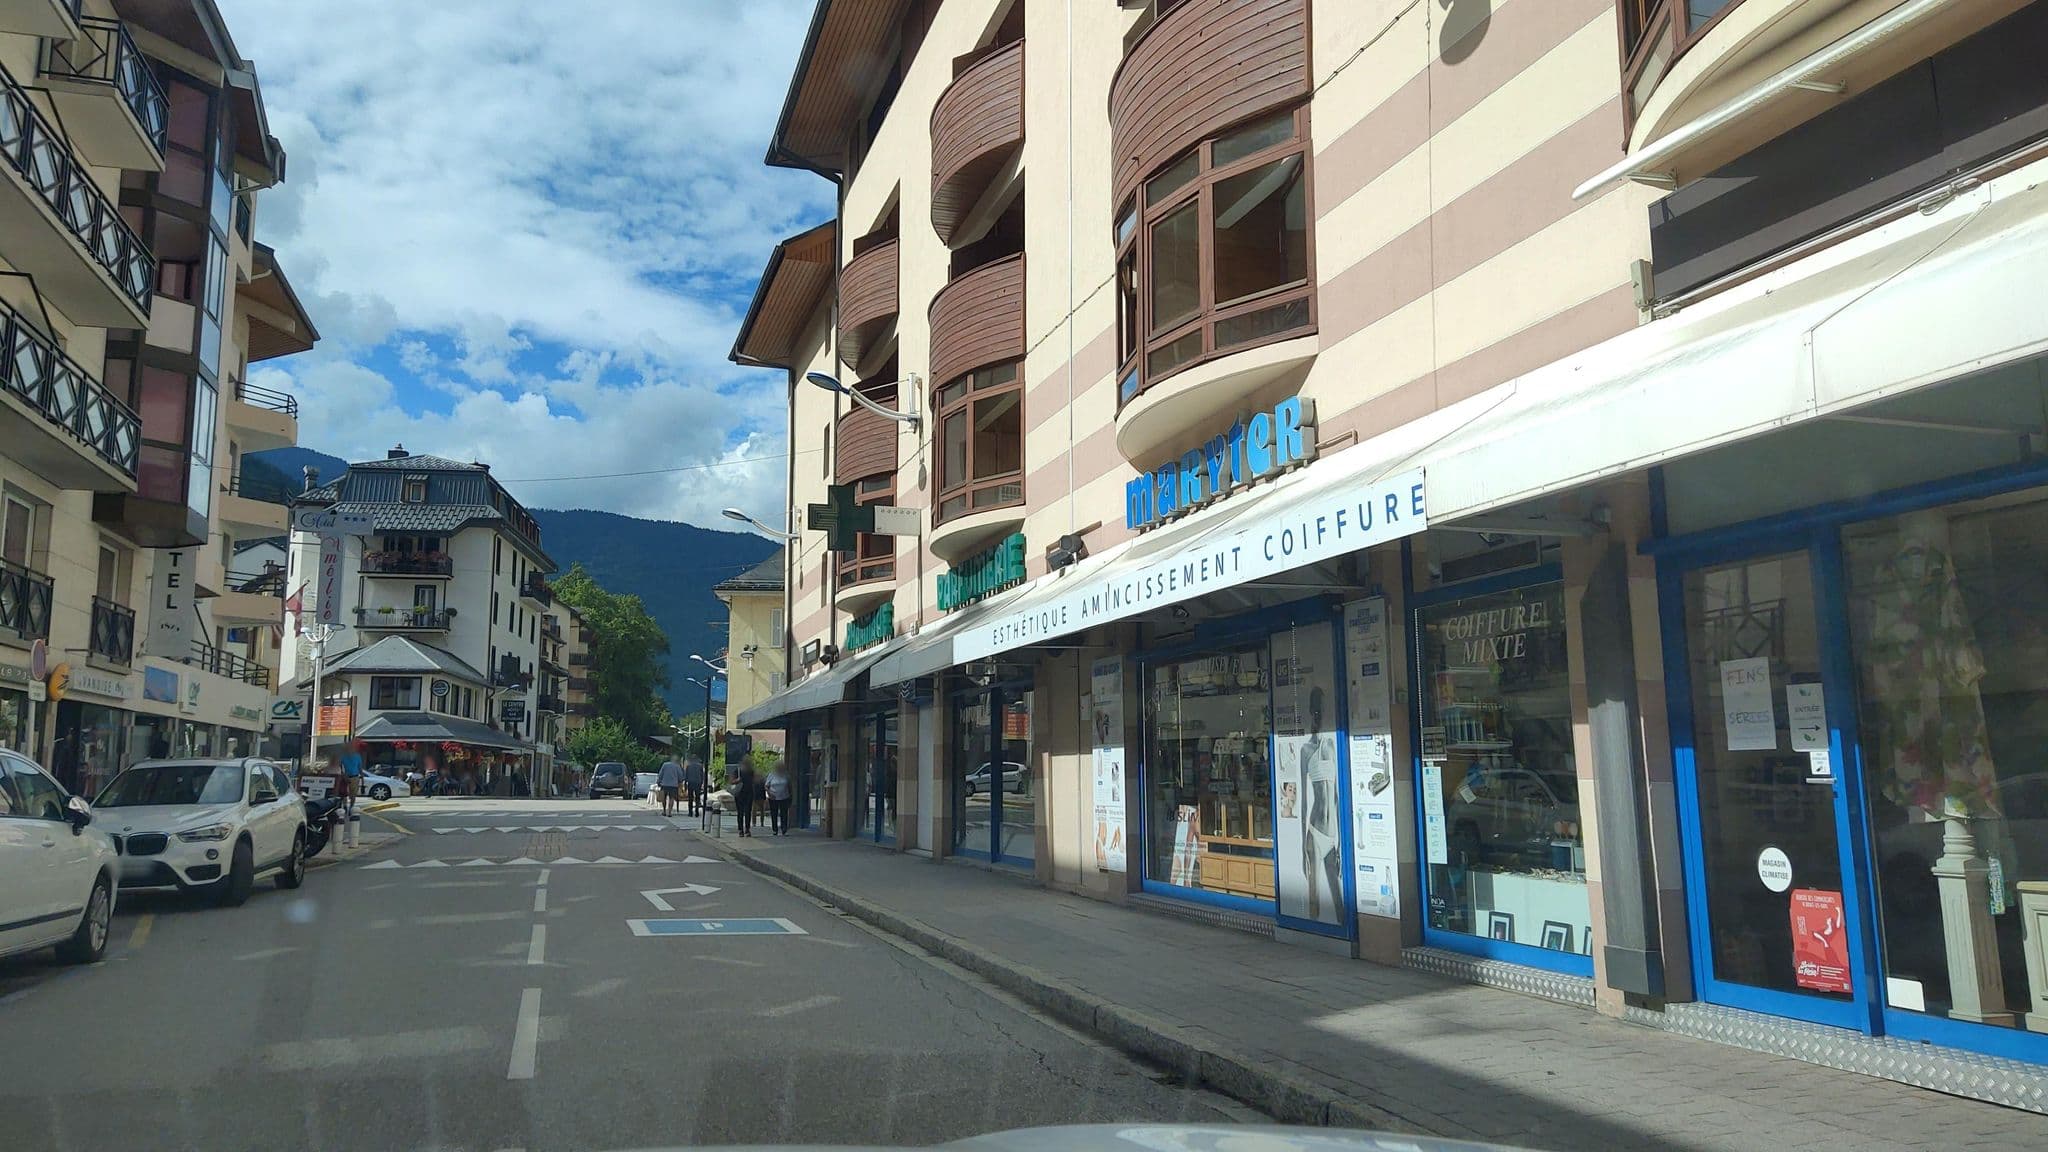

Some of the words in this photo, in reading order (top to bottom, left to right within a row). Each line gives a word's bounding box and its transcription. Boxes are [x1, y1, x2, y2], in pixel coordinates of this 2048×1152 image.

[993, 605, 1067, 646] ESTHÉTIQUE
[1082, 546, 1241, 618] AMINCISSEMENT
[1264, 483, 1425, 561] COIFFURE
[1445, 602, 1543, 641] COIFFURE
[1463, 633, 1527, 665] MIXTE
[1727, 667, 1765, 687] FINS
[1762, 859, 1787, 869] MAGASIN
